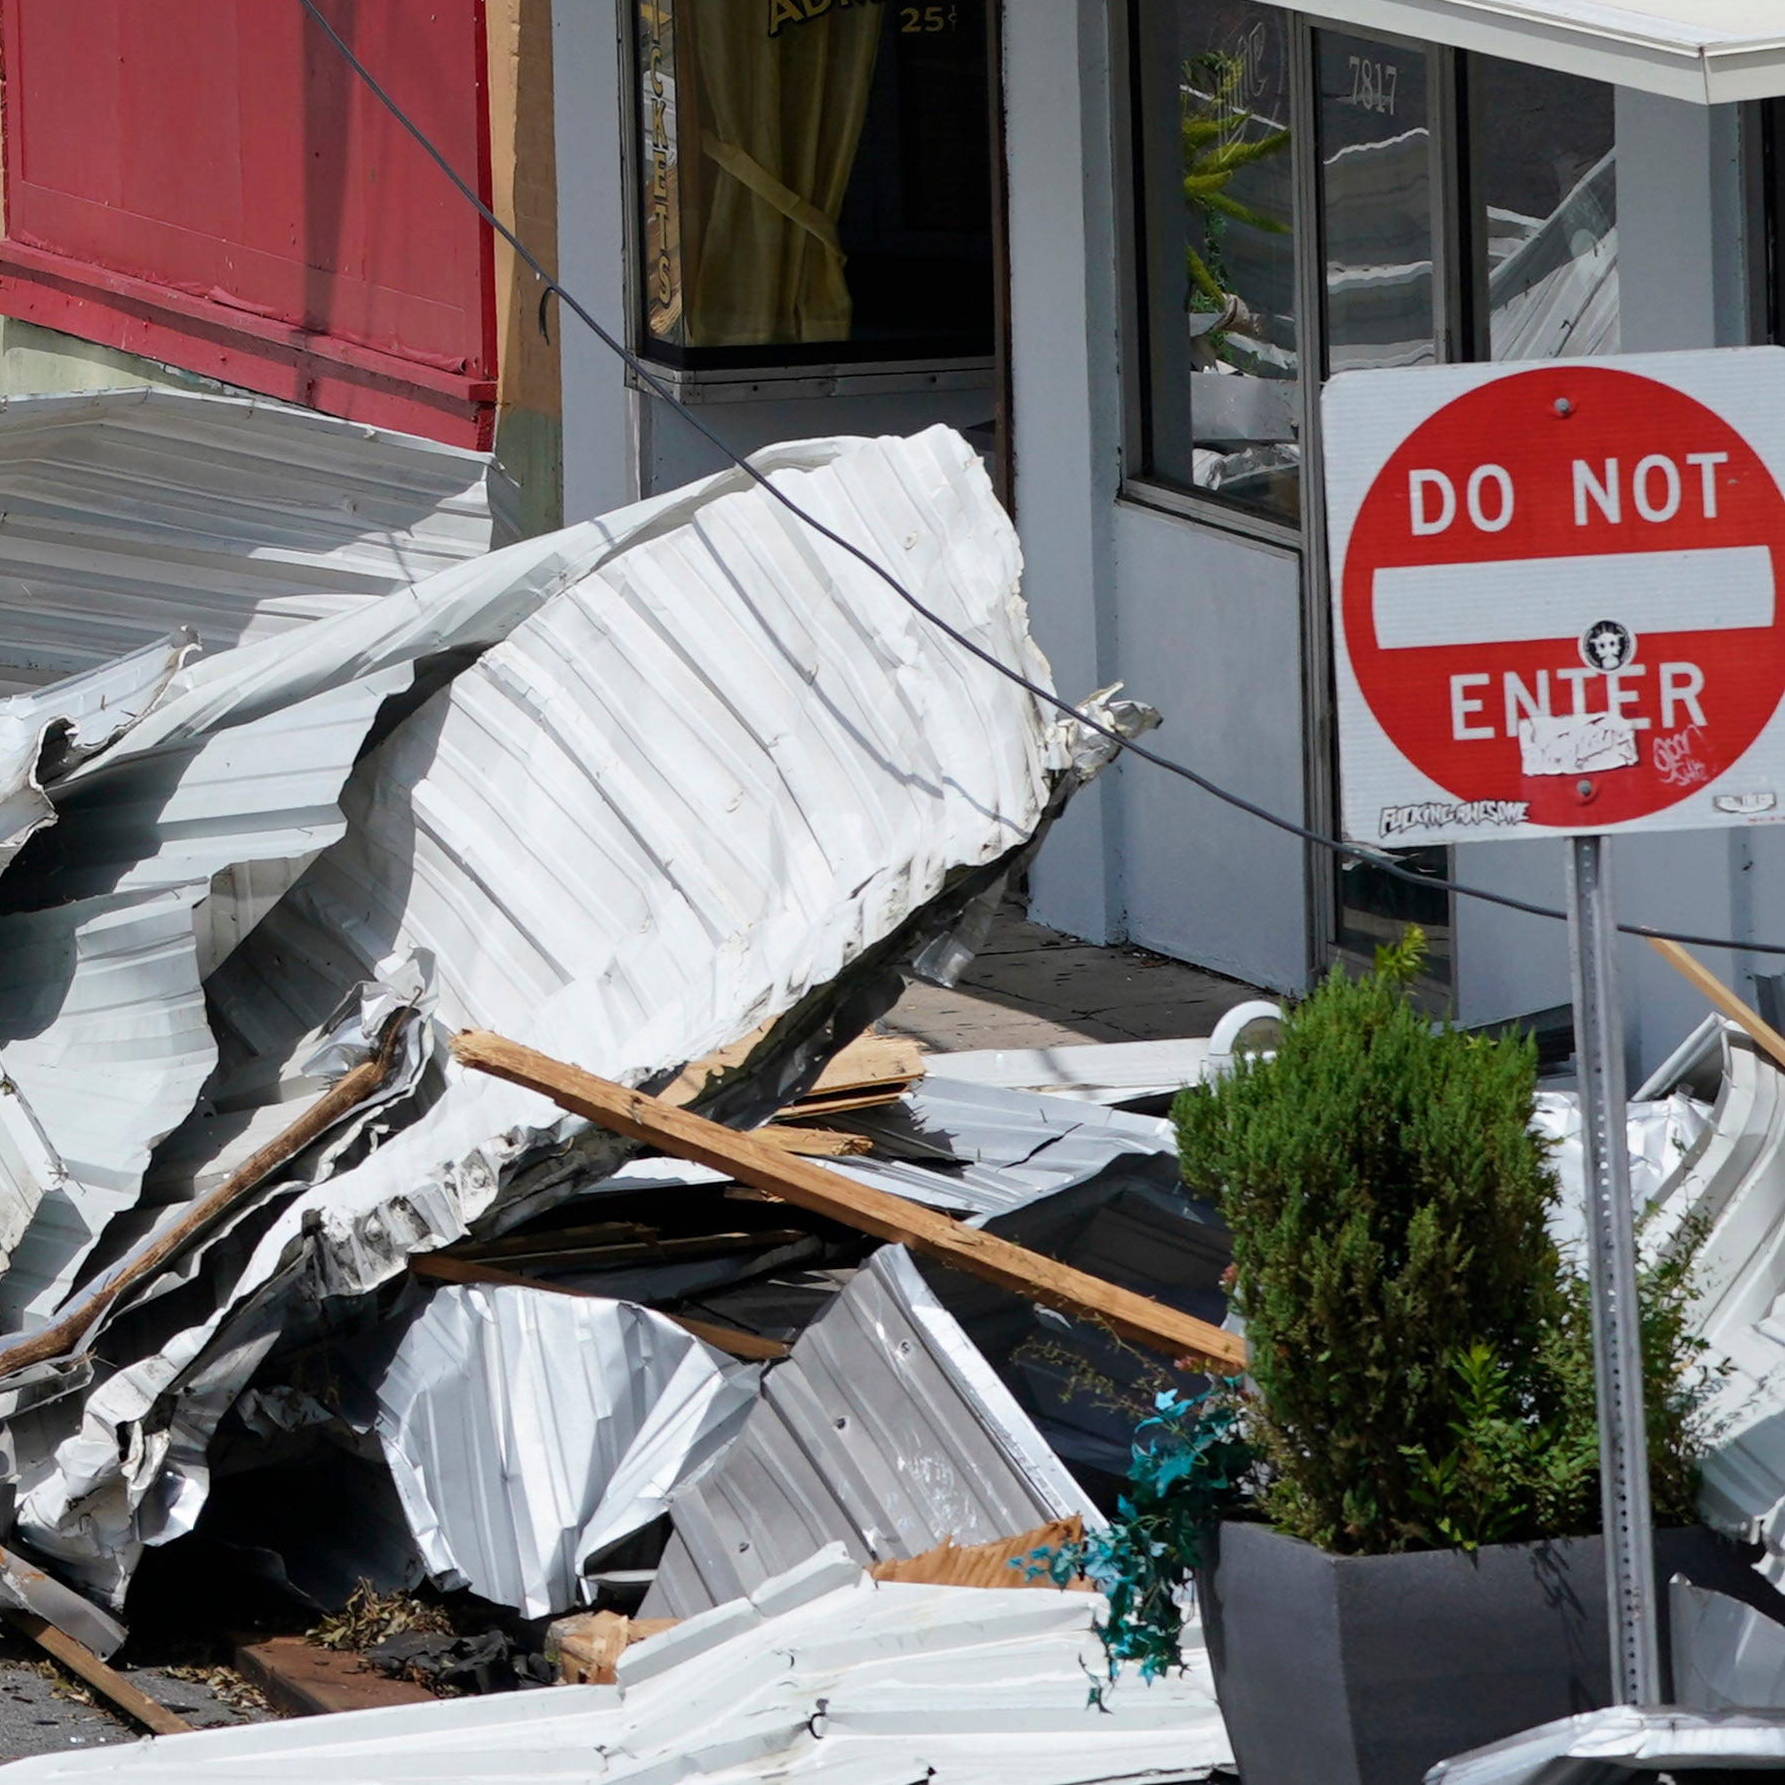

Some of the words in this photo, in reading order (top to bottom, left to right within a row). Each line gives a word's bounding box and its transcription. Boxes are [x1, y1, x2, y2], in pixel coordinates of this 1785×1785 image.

[1348, 55, 1397, 115] 7817
[1408, 464, 1515, 536] DO
[1571, 451, 1729, 527] NOT
[1450, 661, 1708, 741] ENTER
[1379, 803, 1455, 838] FUCKING
[1454, 799, 1531, 826] AWESOME
